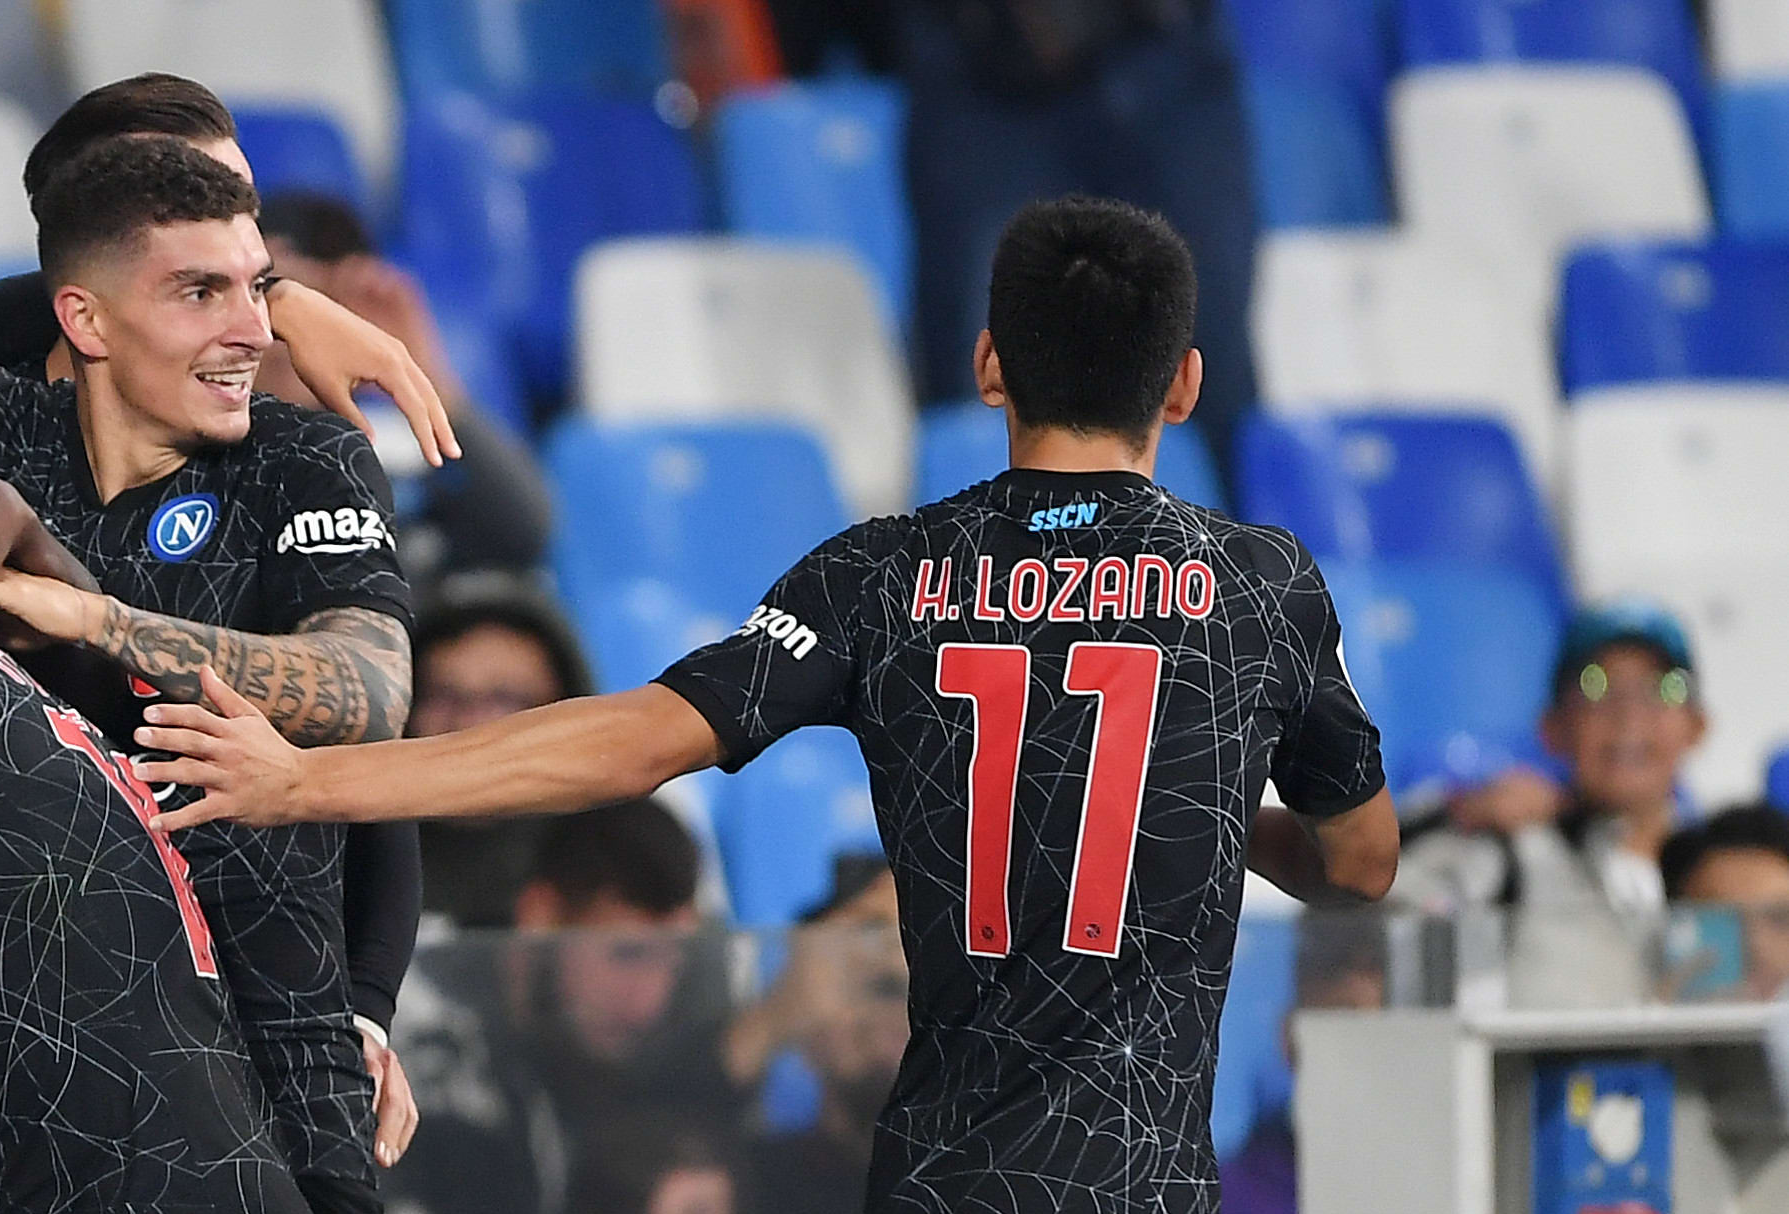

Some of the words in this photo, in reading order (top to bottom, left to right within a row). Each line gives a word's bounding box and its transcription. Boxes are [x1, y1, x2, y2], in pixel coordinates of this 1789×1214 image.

[1028, 502, 1099, 532] SSCN
[911, 556, 960, 621] H.
[974, 554, 1216, 622] LOZANO
[936, 641, 1163, 959] 11
